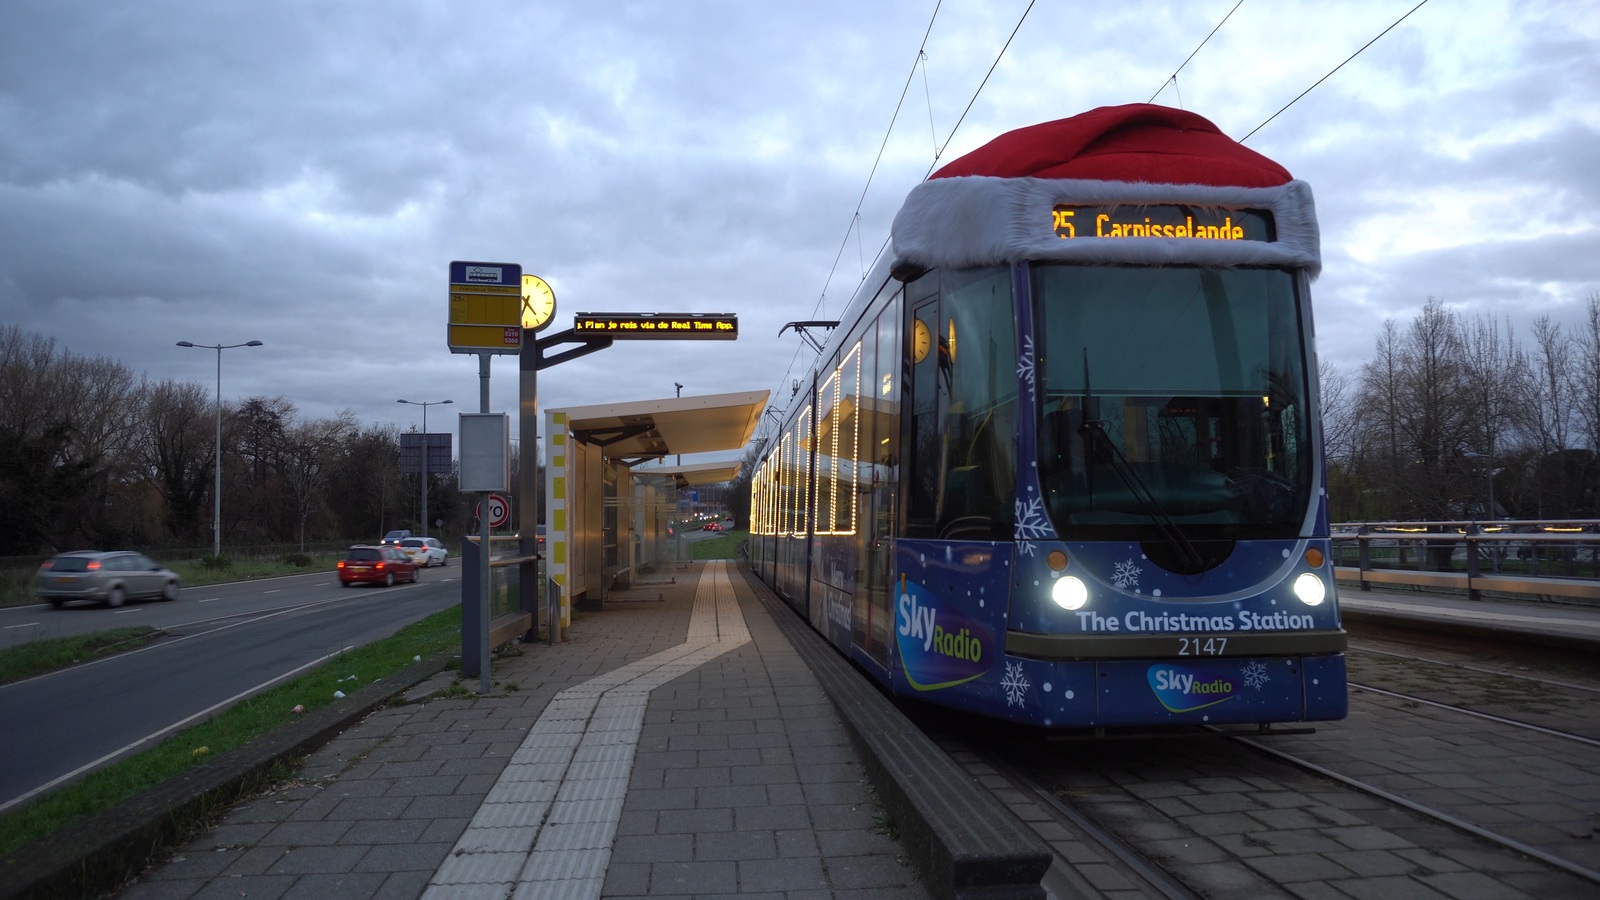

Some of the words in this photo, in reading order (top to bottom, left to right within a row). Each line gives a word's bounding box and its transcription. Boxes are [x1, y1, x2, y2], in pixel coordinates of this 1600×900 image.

[1096, 214, 1244, 240] Carnisselande
[585, 321, 605, 329] Plan
[608, 321, 617, 330] je
[620, 321, 638, 329] reis
[640, 321, 655, 329] via
[657, 321, 669, 329] de
[671, 321, 691, 329] Real
[693, 321, 712, 329] Time
[716, 321, 734, 330] App.
[490, 505, 503, 518] 0
[899, 593, 936, 652] Sky
[933, 624, 982, 663] Radio
[1075, 611, 1119, 631] The
[1125, 611, 1235, 632] Christmas
[1239, 610, 1314, 631] Station
[1178, 637, 1228, 656] 2147
[1155, 669, 1194, 695] Sky
[1192, 680, 1233, 694] Radio
